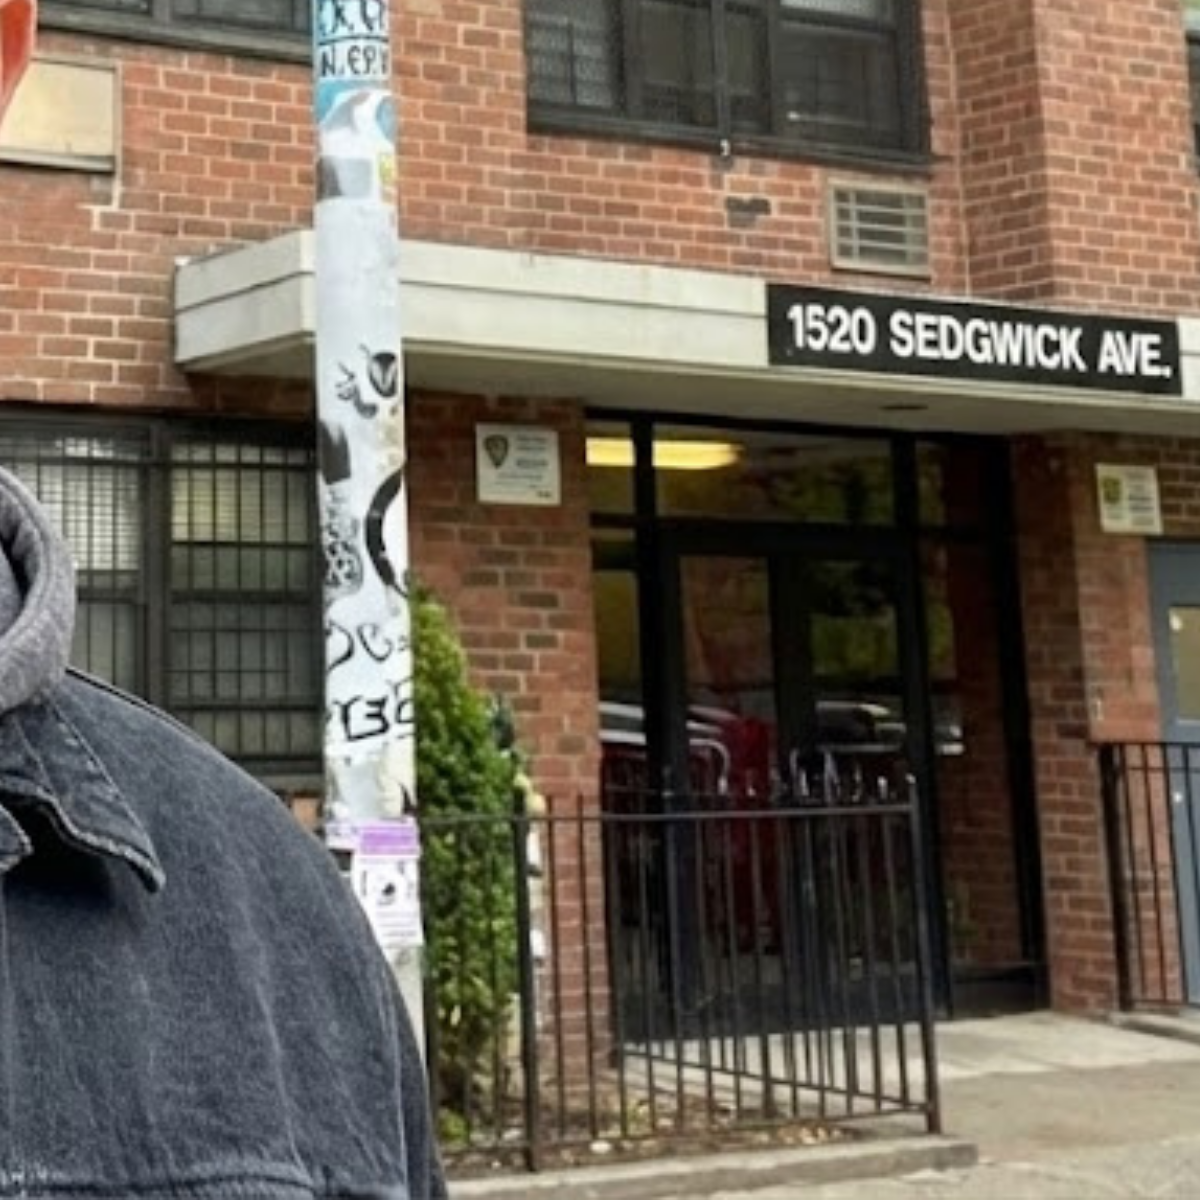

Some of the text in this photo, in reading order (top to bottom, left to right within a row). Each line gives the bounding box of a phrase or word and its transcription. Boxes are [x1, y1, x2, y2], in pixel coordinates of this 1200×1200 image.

[787, 303, 1172, 379] 1520 SEDGWICK AVE.
